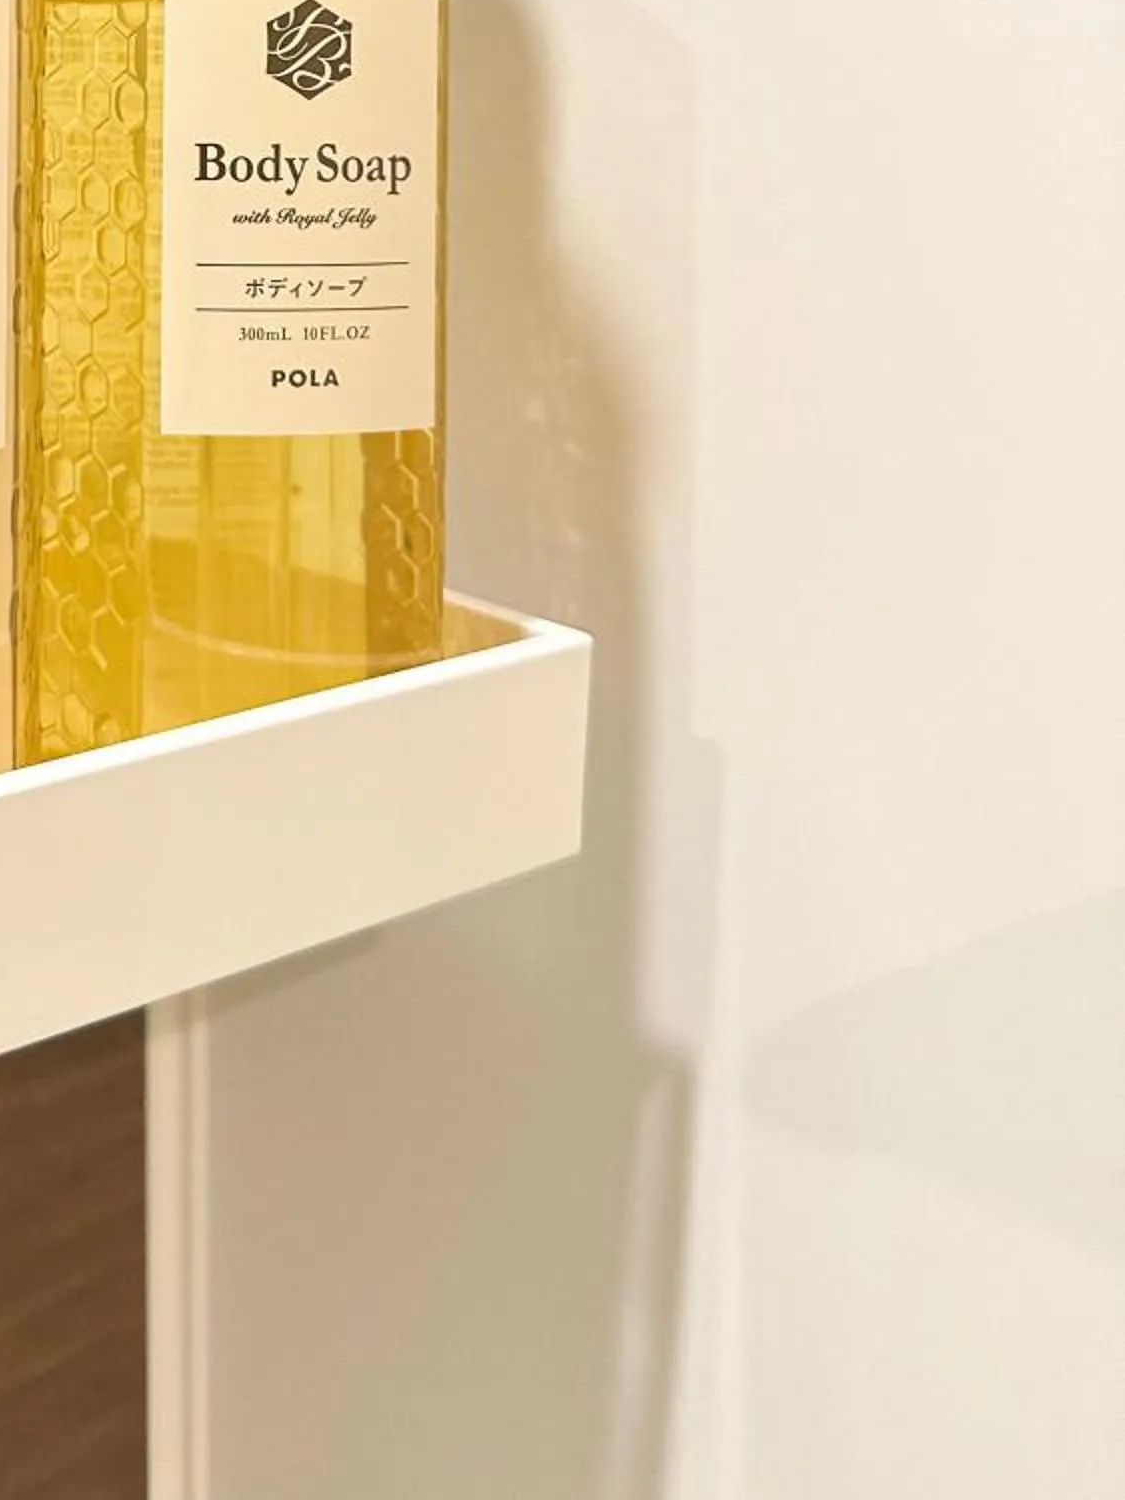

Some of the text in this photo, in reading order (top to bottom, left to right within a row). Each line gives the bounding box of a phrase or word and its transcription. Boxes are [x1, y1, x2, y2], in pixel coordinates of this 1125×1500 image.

[194, 142, 412, 197] Body Soap
[232, 207, 377, 230] with Royal Jelly
[244, 275, 367, 299] ボディソープ
[238, 325, 370, 341] 300mL 10FL.OZ
[271, 368, 340, 389] POLA
